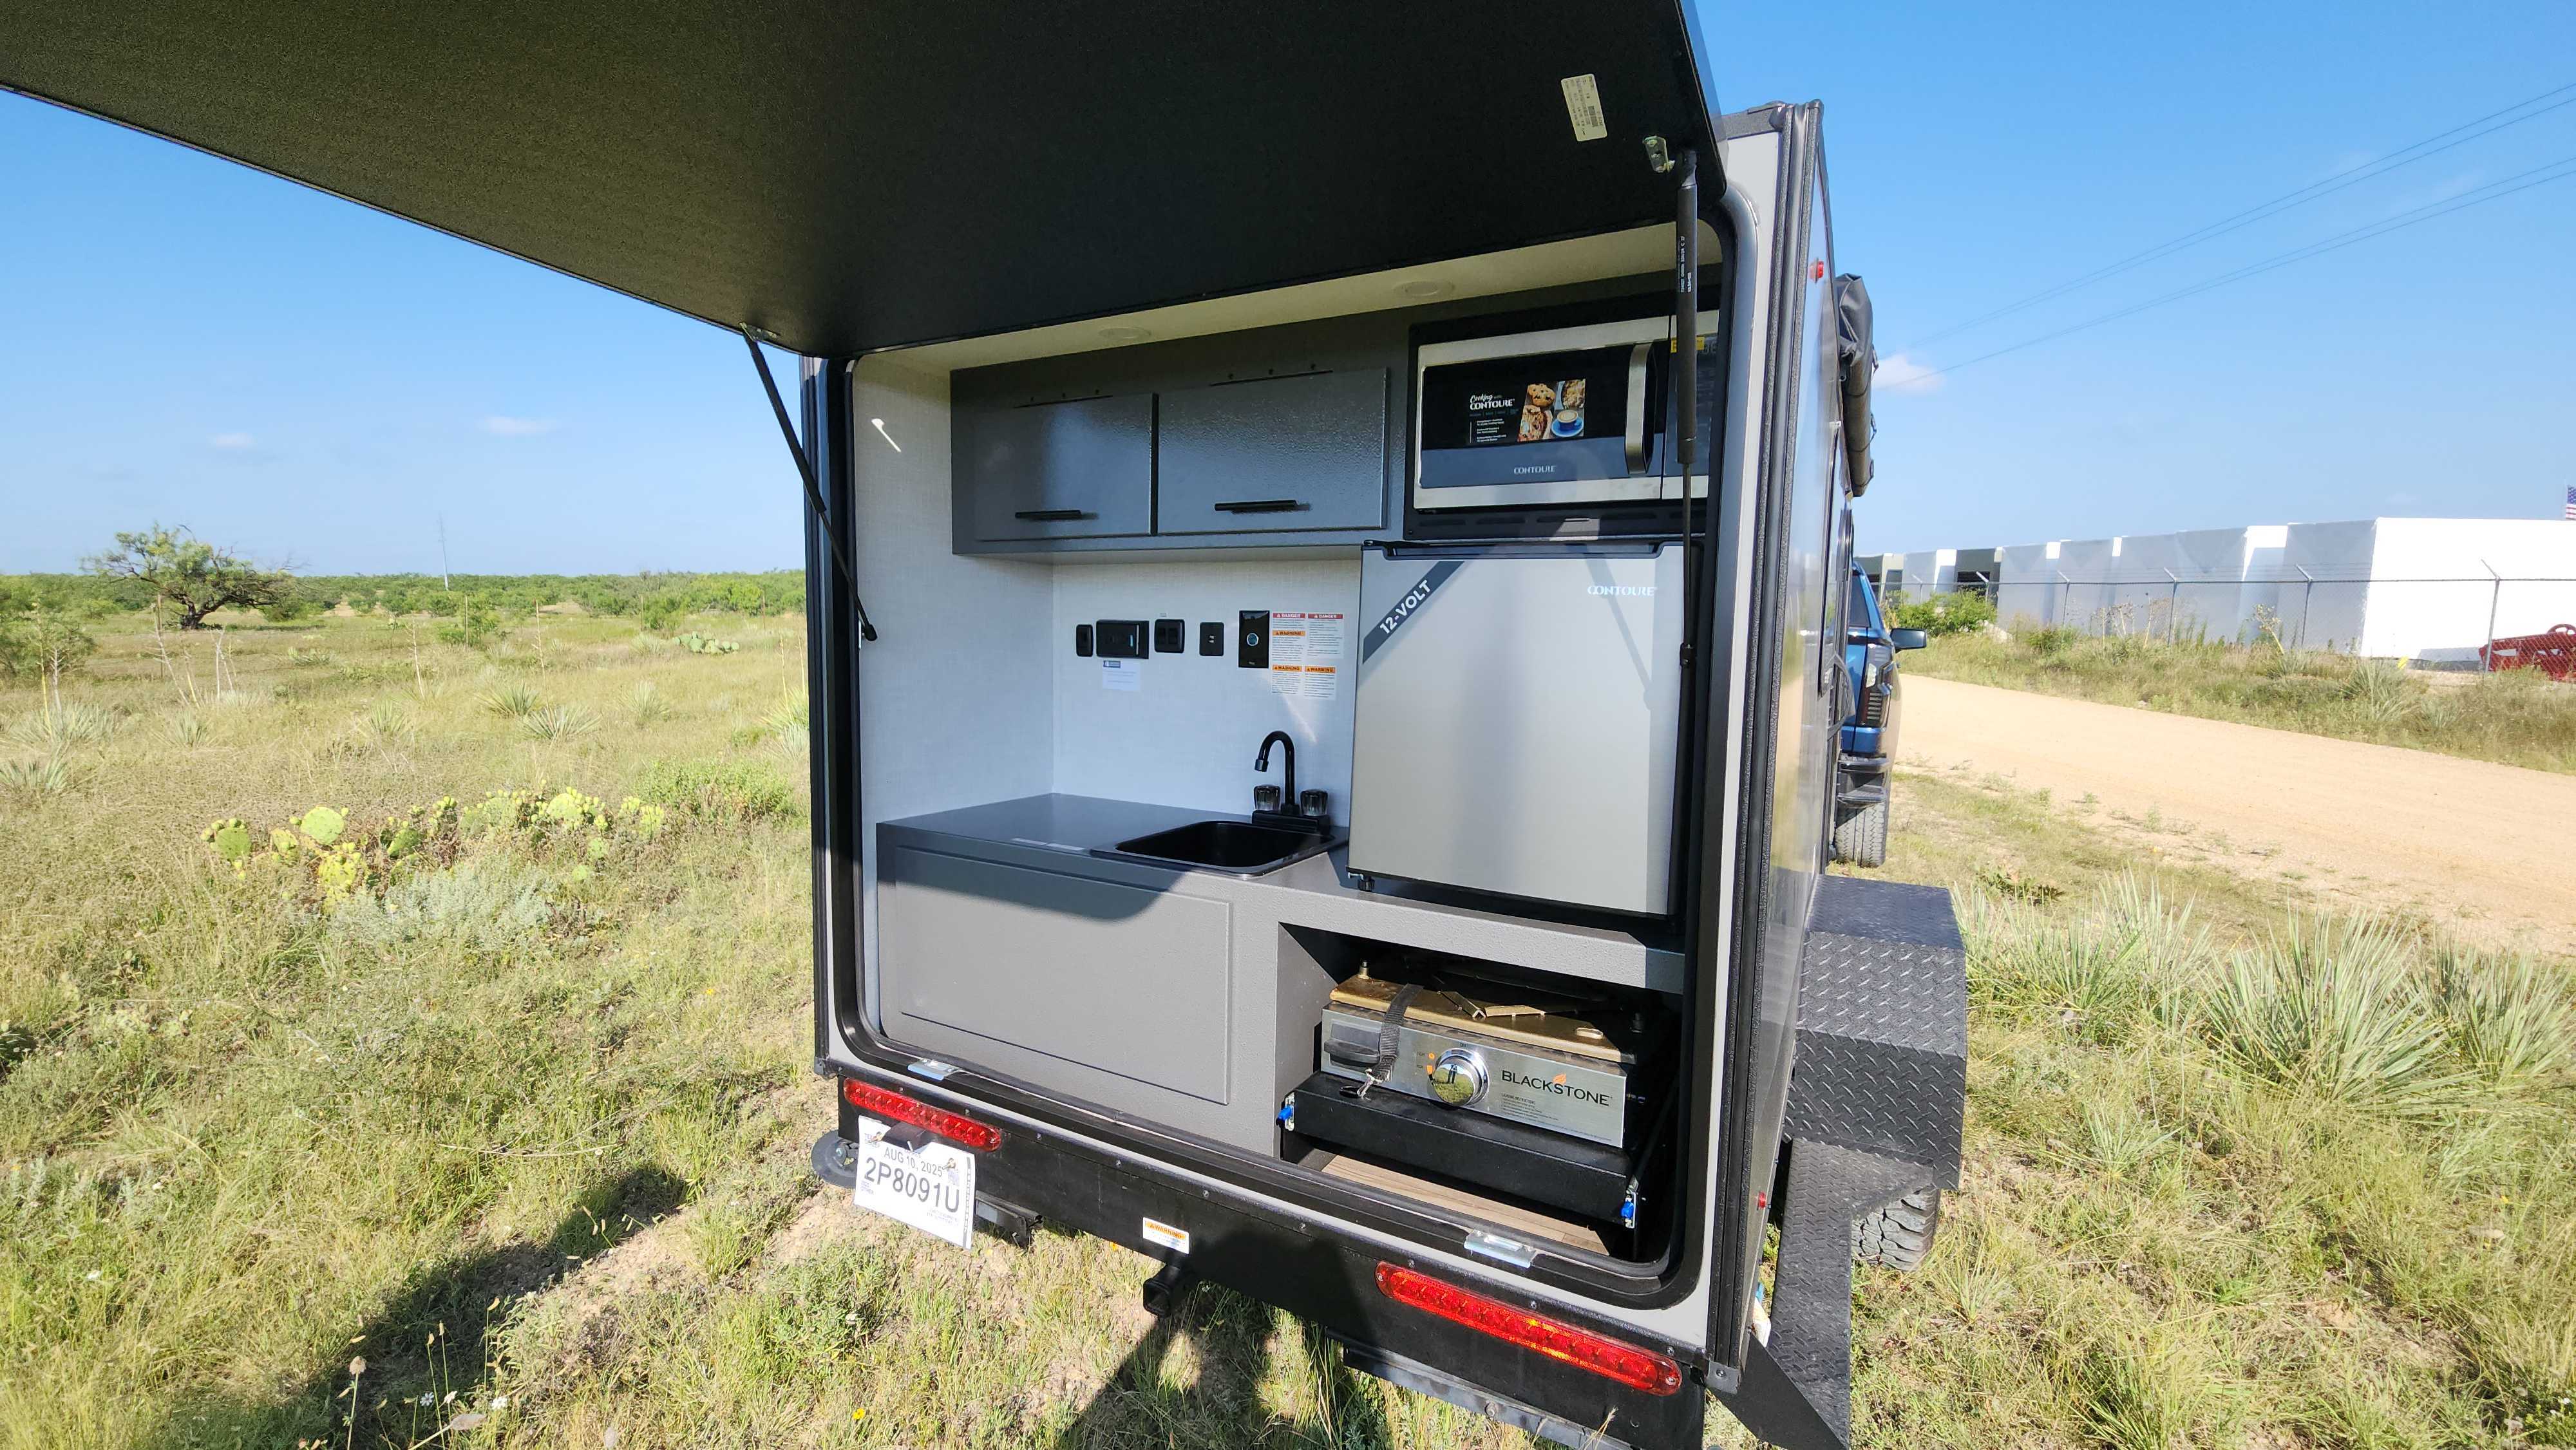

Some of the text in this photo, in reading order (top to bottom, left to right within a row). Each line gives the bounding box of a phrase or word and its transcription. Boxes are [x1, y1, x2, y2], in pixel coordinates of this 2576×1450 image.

[1470, 394, 1493, 404] Cooking
[1470, 399, 1513, 410] CONTOURE
[1587, 585, 1654, 596] CONTOURE
[1379, 579, 1430, 634] 12-VOLT
[1502, 1069, 1609, 1106] BLACKSTONE
[884, 1147, 904, 1163] AUG
[907, 1156, 918, 1171] 10,
[920, 1161, 943, 1177] 2025
[864, 1157, 960, 1213] 2P8091U
